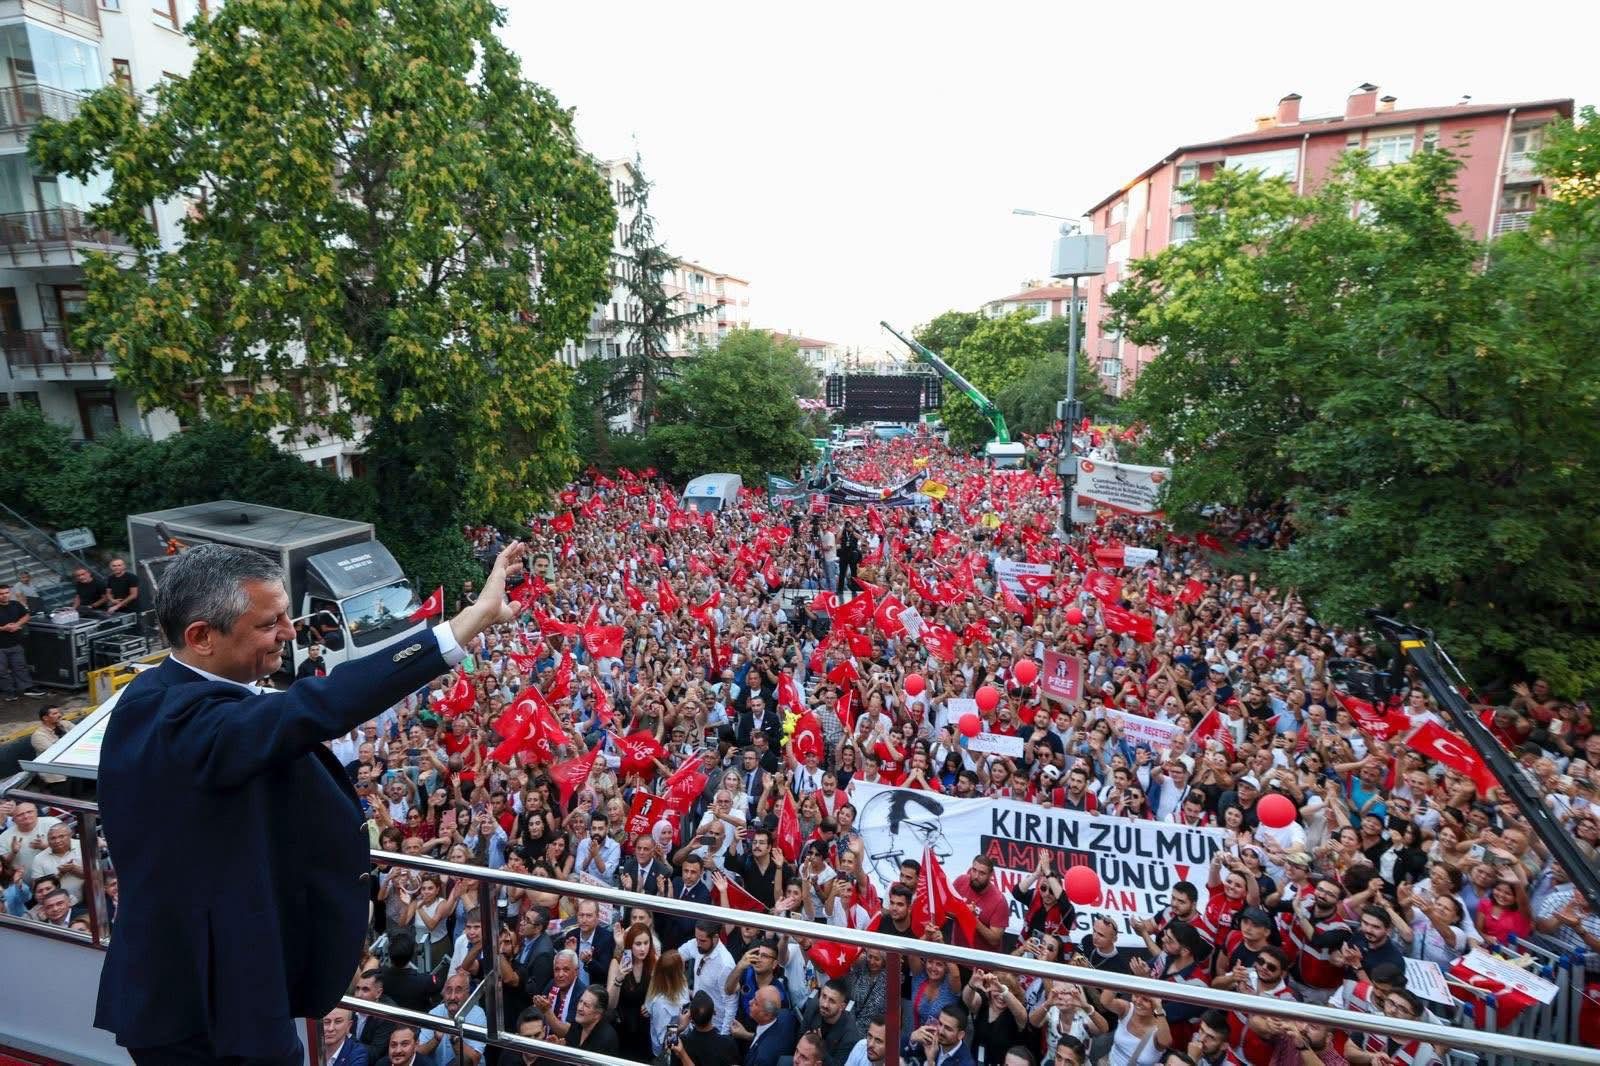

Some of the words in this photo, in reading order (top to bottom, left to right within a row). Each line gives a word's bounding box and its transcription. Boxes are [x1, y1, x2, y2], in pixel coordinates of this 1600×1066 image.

[1359, 720, 1390, 731] CHP
[992, 807, 1080, 849] KIRIN
[1089, 822, 1226, 865] ZULMÜN
